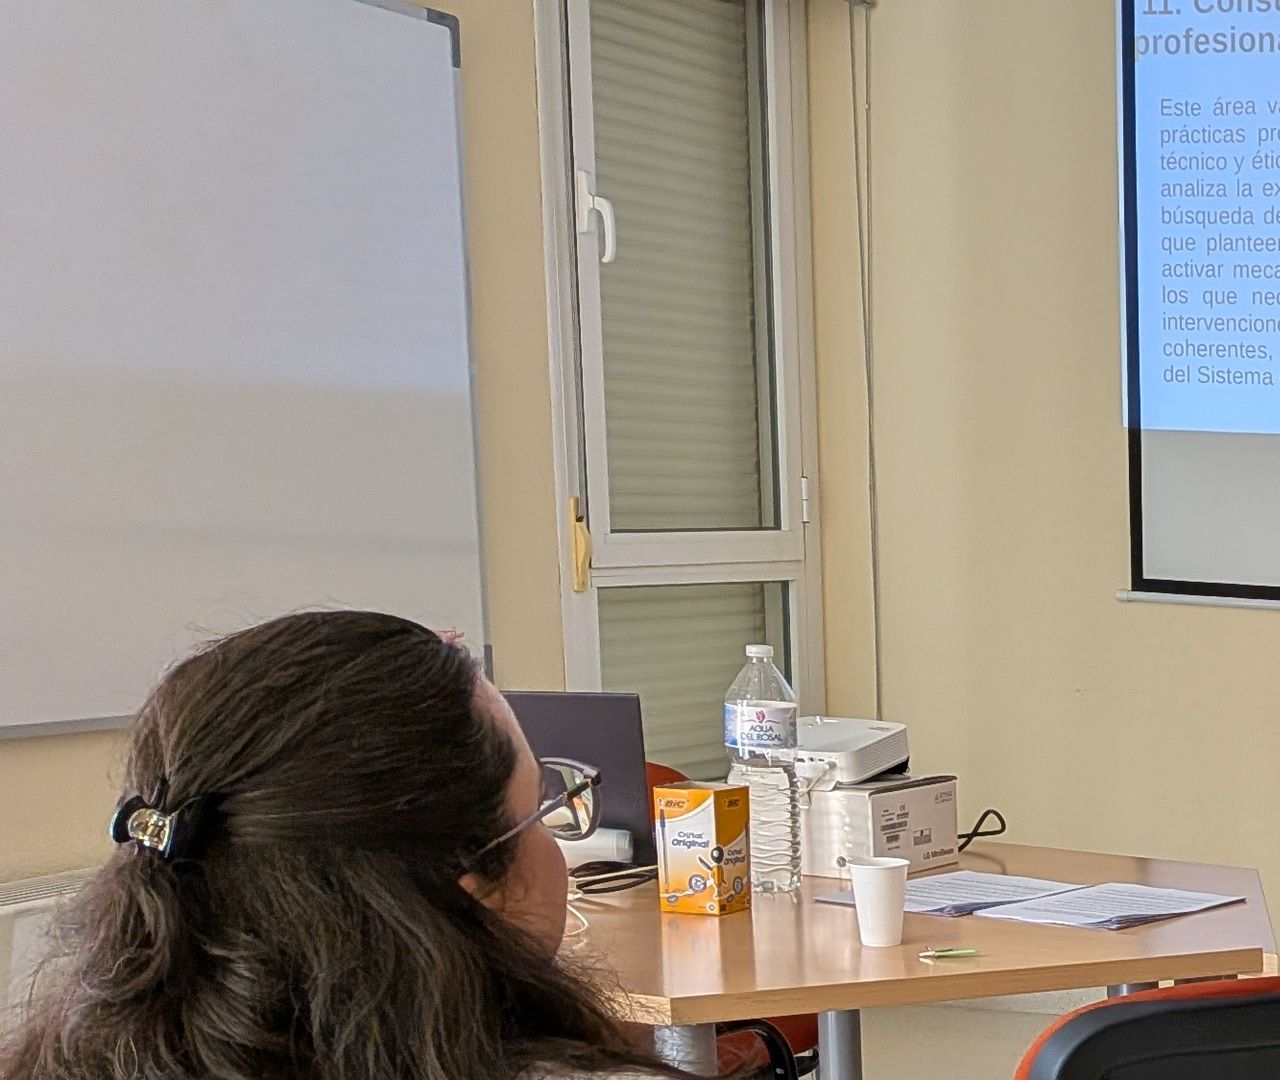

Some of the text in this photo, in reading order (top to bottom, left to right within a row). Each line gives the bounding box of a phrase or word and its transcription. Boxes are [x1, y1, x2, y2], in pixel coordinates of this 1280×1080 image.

[1160, 98, 1202, 118] Este
[1212, 95, 1257, 117] área
[1160, 123, 1246, 149] prácticas
[1159, 150, 1228, 171] técnico
[1232, 155, 1246, 176] y
[1160, 178, 1228, 198] analiza
[1236, 177, 1254, 198] la
[1161, 204, 1255, 230] búsqueda
[1161, 236, 1197, 256] que
[1161, 258, 1225, 279] activar
[1161, 284, 1189, 305] los
[1202, 289, 1238, 310] que
[1162, 338, 1273, 362] coherentes,
[1162, 363, 1191, 384] del
[1197, 364, 1275, 387] Sistema
